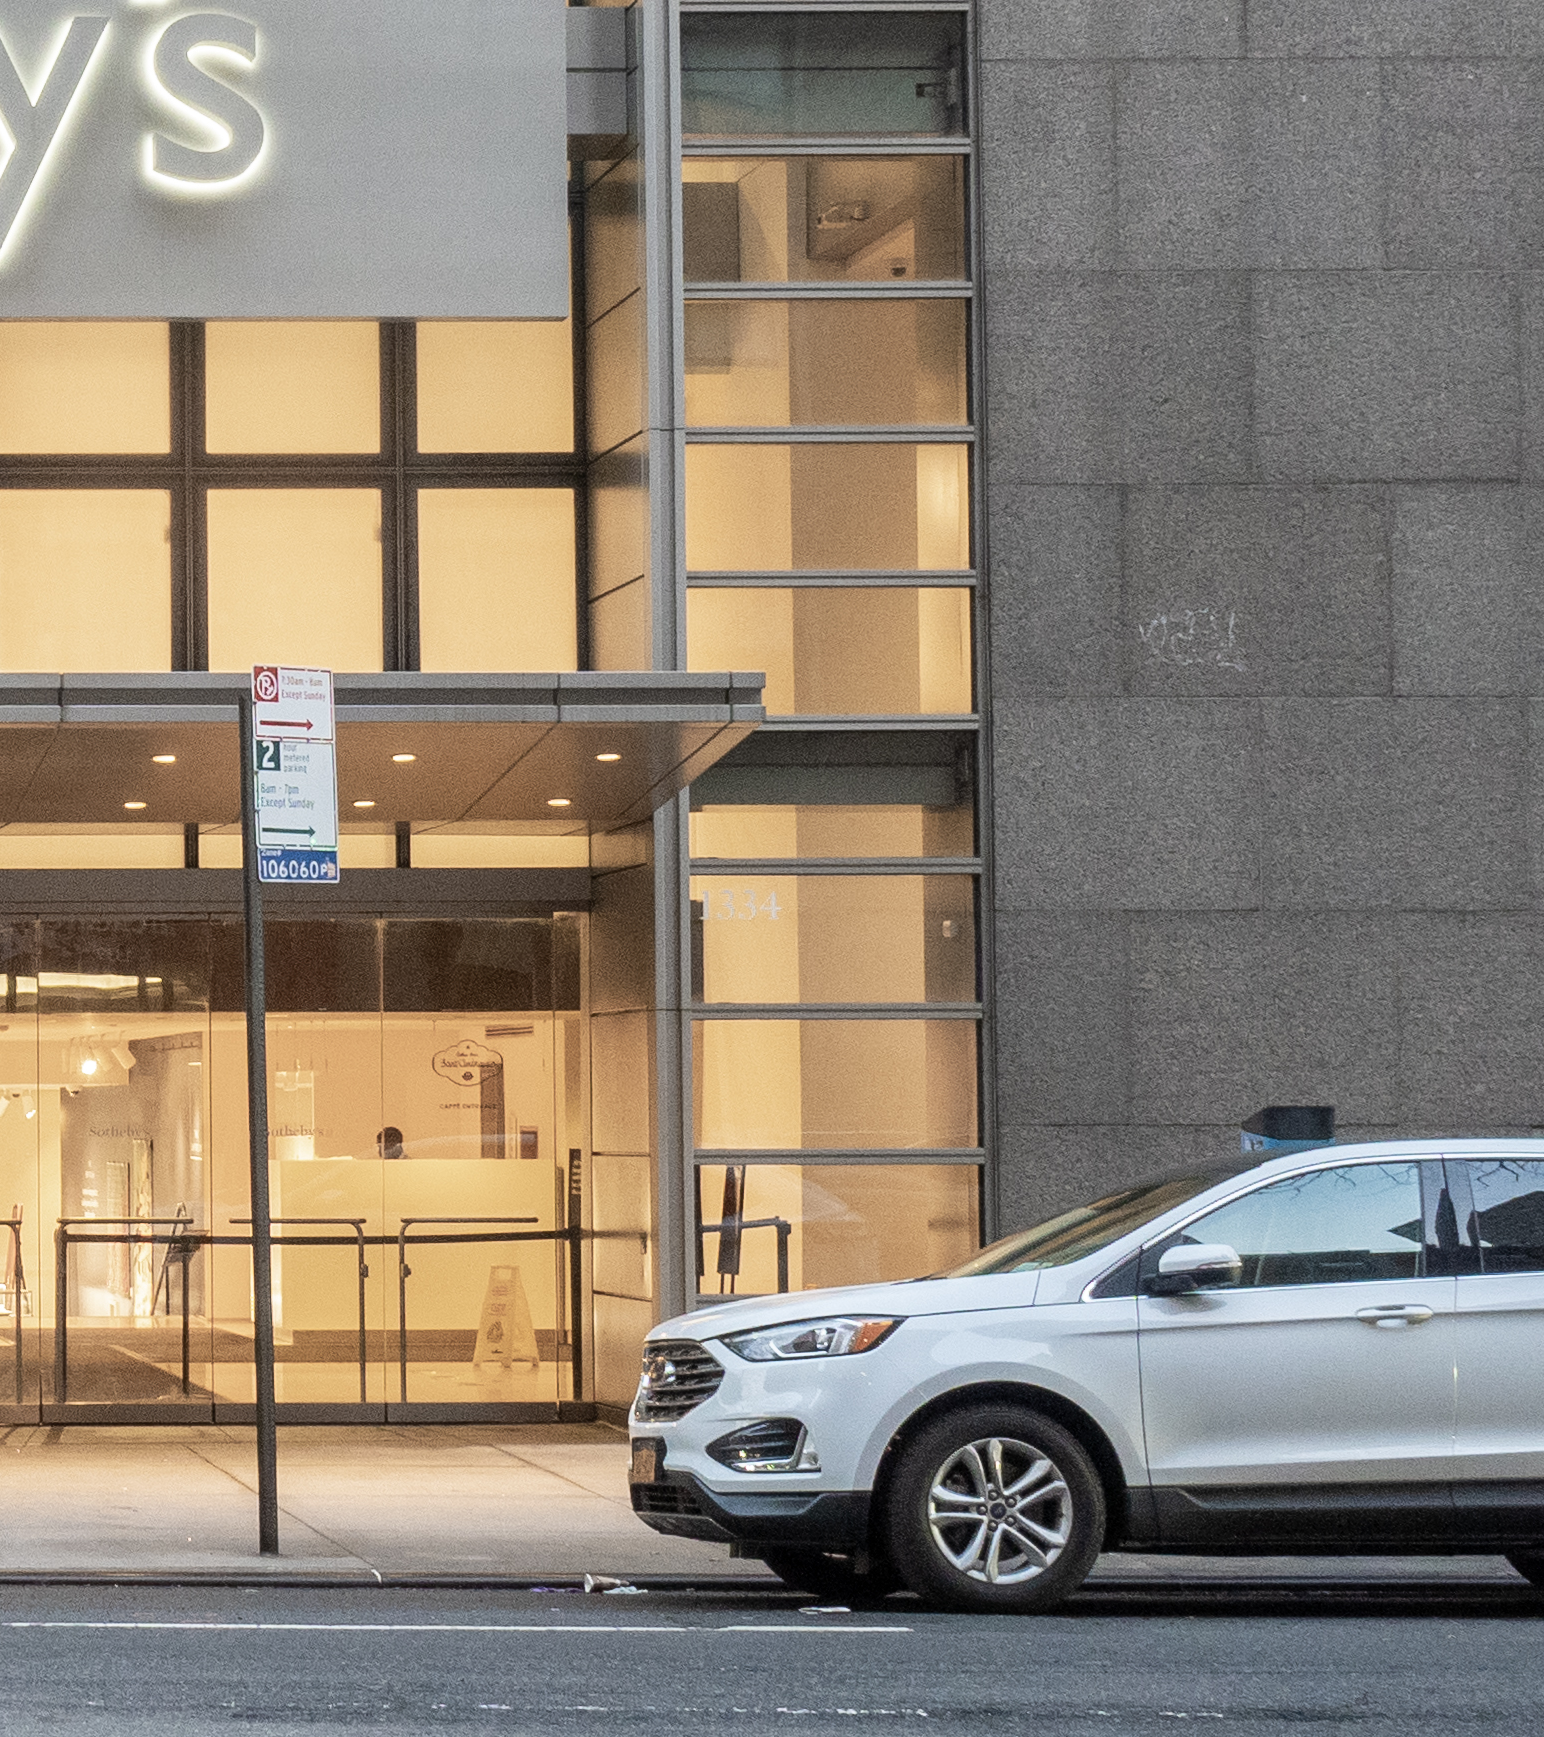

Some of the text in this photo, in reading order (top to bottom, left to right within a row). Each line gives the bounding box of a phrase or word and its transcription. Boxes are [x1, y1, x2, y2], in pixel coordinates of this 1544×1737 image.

[281, 689, 326, 702] Except Sunday
[262, 741, 276, 768] 2
[283, 753, 310, 763] metered
[283, 765, 308, 775] parking
[260, 797, 315, 811] Except Sunday
[262, 859, 319, 879] 106060
[700, 889, 783, 921] 1334
[267, 1125, 324, 1140] otheby's
